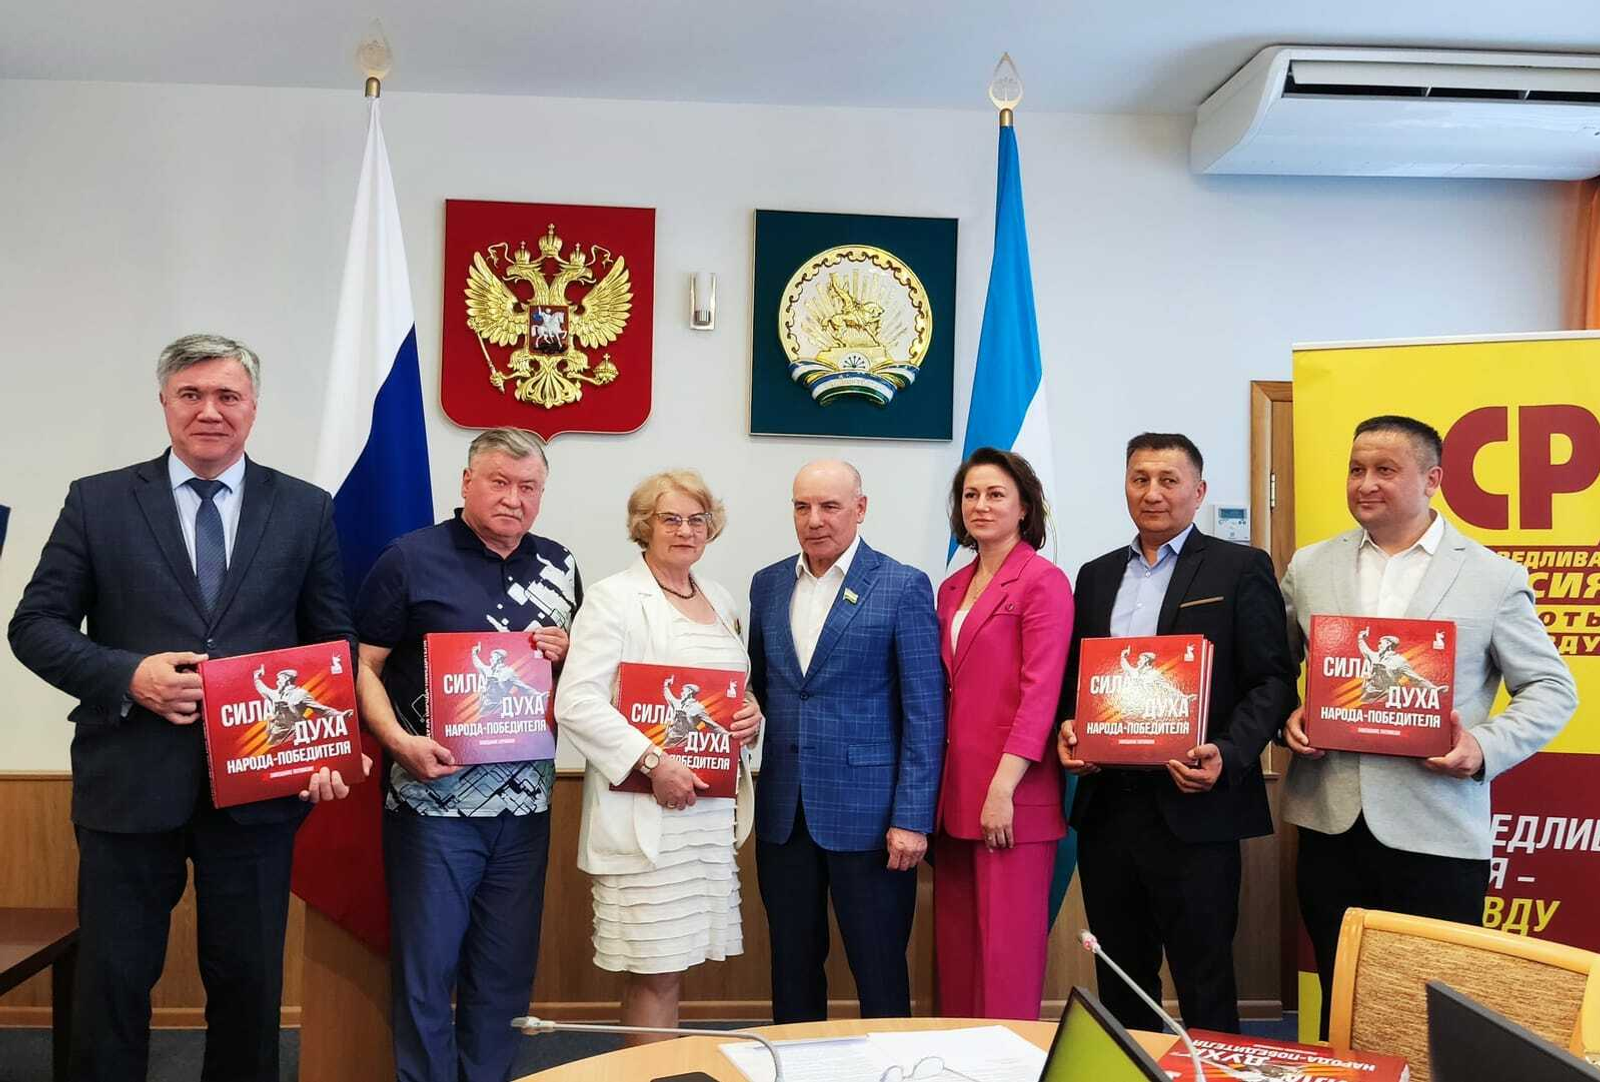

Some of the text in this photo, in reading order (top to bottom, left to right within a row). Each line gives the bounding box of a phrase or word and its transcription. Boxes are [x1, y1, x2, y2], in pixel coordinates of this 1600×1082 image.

[1440, 403, 1600, 530] СР
[1551, 635, 1600, 654] ДУ
[1323, 656, 1372, 679] СИЛА
[443, 673, 488, 694] СИЛА
[500, 695, 545, 718] ДУХА
[1385, 686, 1440, 709] ДУХА
[221, 699, 275, 727] СИЛА
[631, 703, 675, 724] СИЛА
[1321, 707, 1441, 728] НАРОДА-ПОБЕДИТЕЛЯ
[294, 715, 348, 746] ДУХА
[445, 719, 547, 738] НАРОДА-ПОБЕДИТЕЛЯ
[1087, 721, 1190, 735] НАРОДА-ПОБЕДИТЕЛЯ
[685, 731, 730, 753] ДУХА
[227, 740, 352, 774] НАРОДА-ПОБЕДИТЕЛЯ
[1482, 896, 1561, 937] ВДУ
